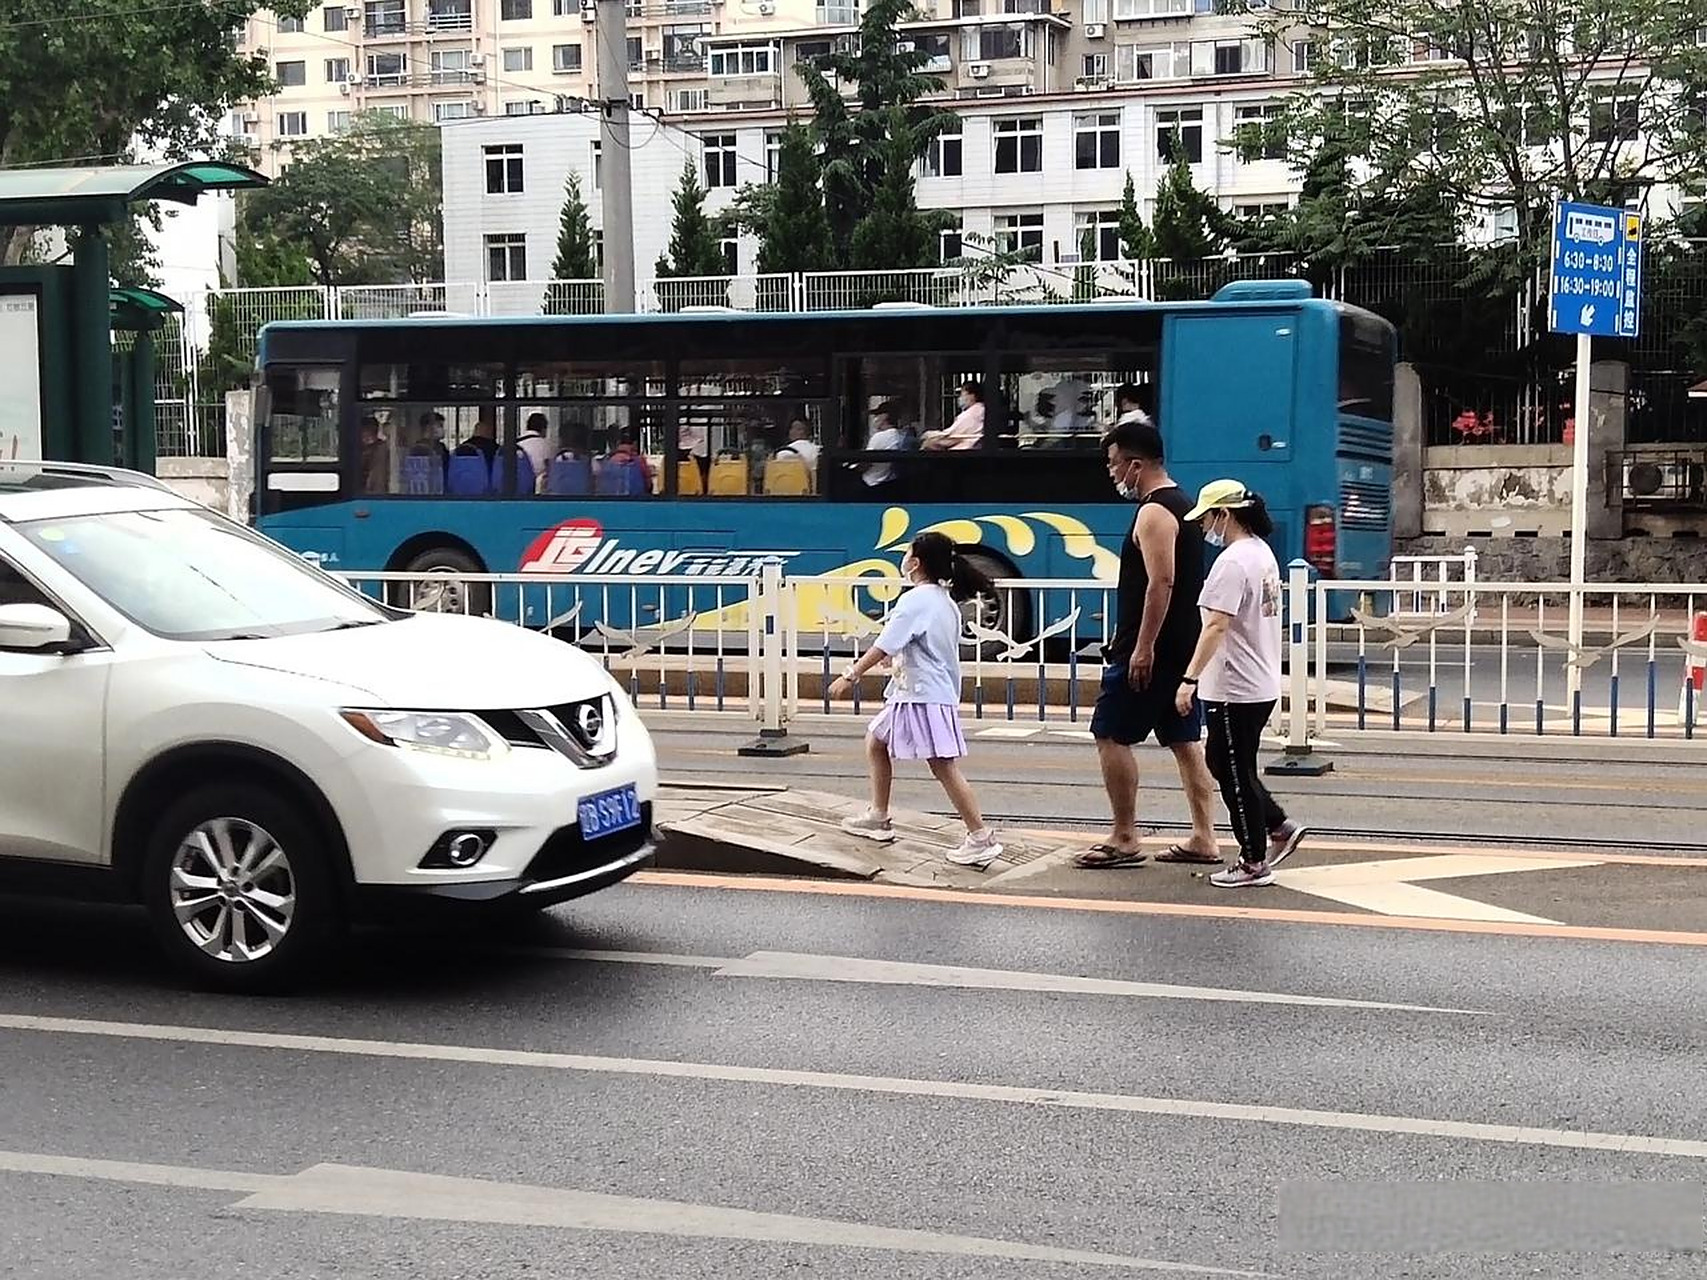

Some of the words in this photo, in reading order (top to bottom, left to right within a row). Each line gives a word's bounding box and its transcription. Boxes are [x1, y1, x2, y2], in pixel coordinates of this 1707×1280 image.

[1564, 250, 1613, 272] 6:30-8:30
[1560, 275, 1615, 298] 16:30-19:00
[1624, 247, 1637, 329] 全程监控
